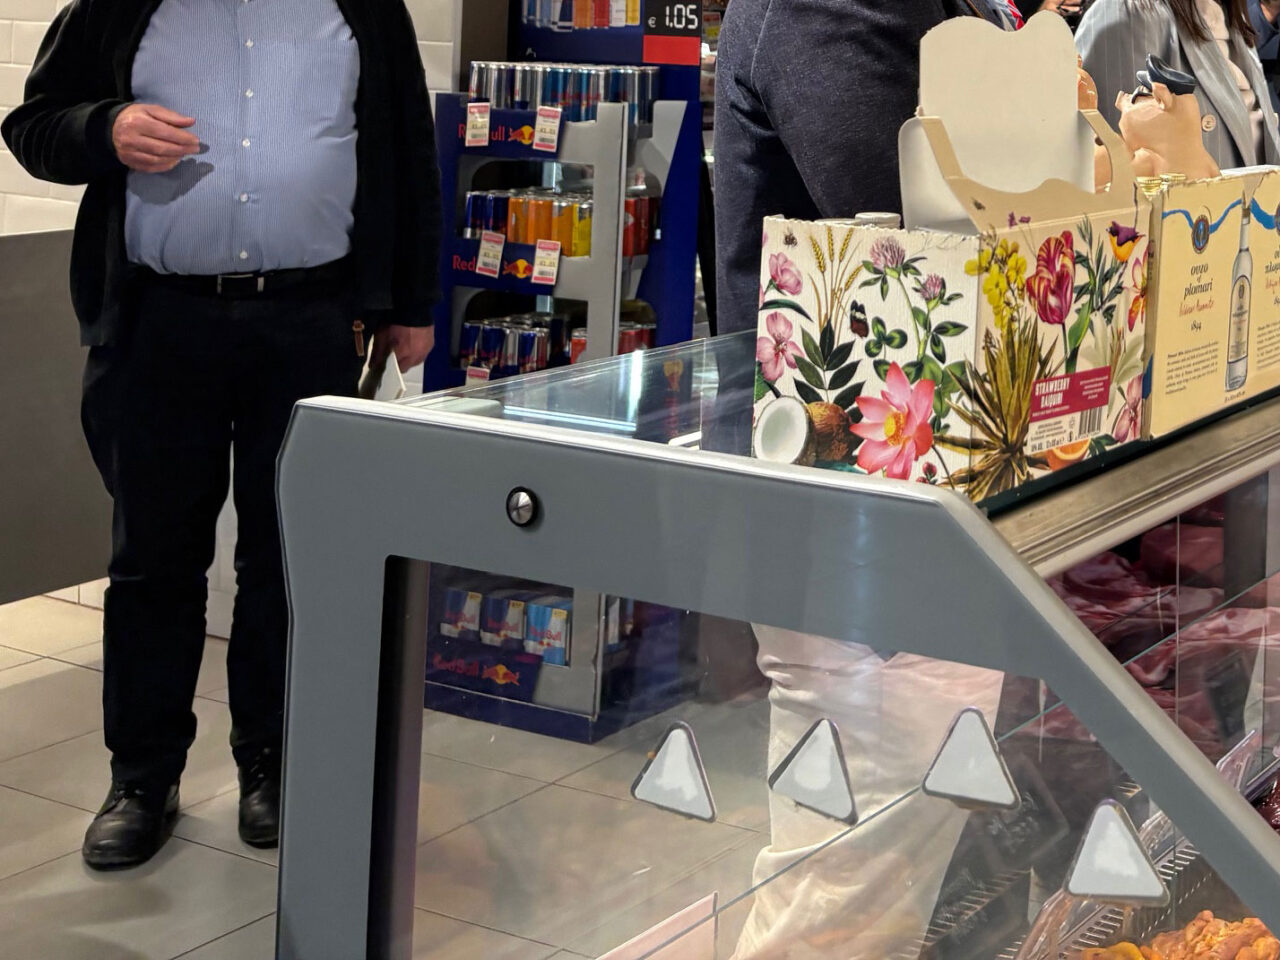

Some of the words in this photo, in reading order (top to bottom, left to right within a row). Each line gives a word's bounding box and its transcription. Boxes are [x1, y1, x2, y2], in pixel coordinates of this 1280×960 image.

[648, 17, 656, 28] €
[665, 4, 698, 29] 1.05
[452, 254, 476, 272] Red
[1190, 263, 1209, 276] ouzo
[1183, 278, 1213, 300] plomari
[1035, 377, 1070, 396] STRAWBERRY
